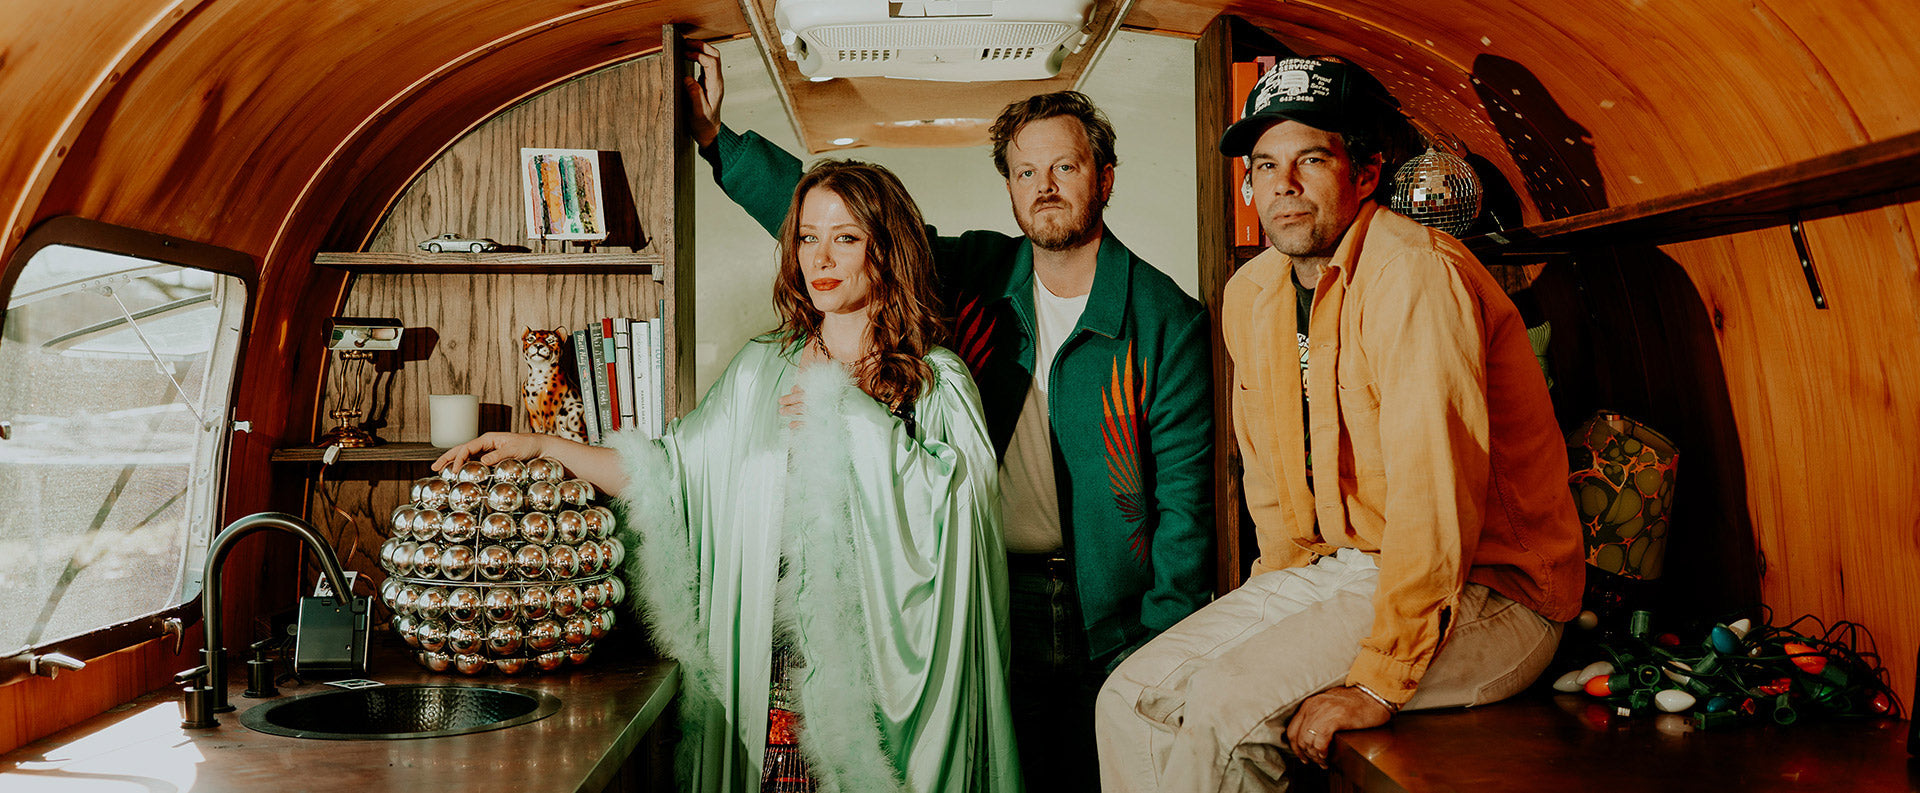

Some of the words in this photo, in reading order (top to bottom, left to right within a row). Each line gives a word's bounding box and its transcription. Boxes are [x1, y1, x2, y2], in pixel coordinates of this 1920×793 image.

[1279, 58, 1321, 66] DISPOSAL
[1312, 73, 1332, 84] Proud
[1310, 82, 1330, 92] Serve
[577, 333, 586, 350] Matt
[577, 350, 587, 366] Haig
[595, 357, 605, 379] where
